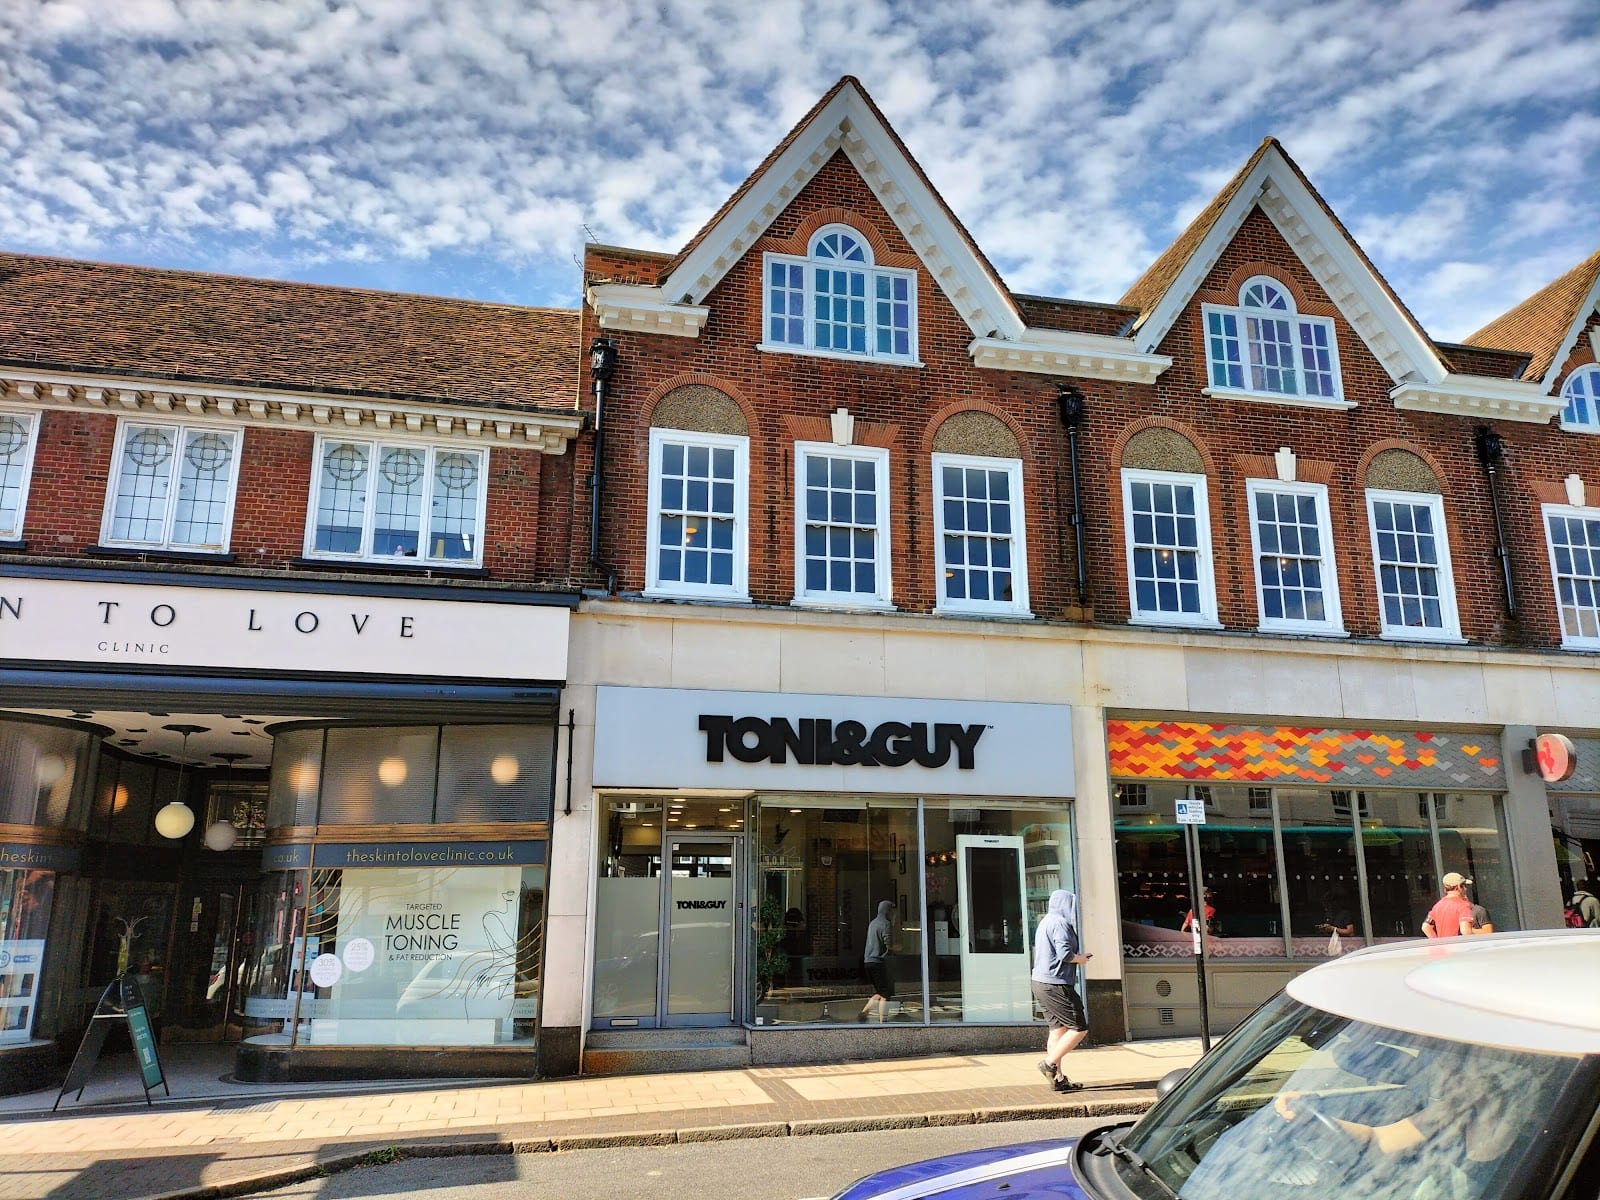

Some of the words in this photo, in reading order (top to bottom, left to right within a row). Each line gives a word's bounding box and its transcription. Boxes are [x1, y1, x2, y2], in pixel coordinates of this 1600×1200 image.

[98, 601, 176, 627] TO
[248, 609, 414, 638] LOVE
[97, 641, 169, 654] CLINIC
[699, 714, 987, 770] TONI&GUY
[346, 846, 514, 862] theskintoloveclinic.co.uk
[405, 903, 443, 911] TARGETED
[676, 900, 727, 910] TONI&GUY
[385, 913, 461, 930] MUSCLE
[385, 934, 459, 951] TONING
